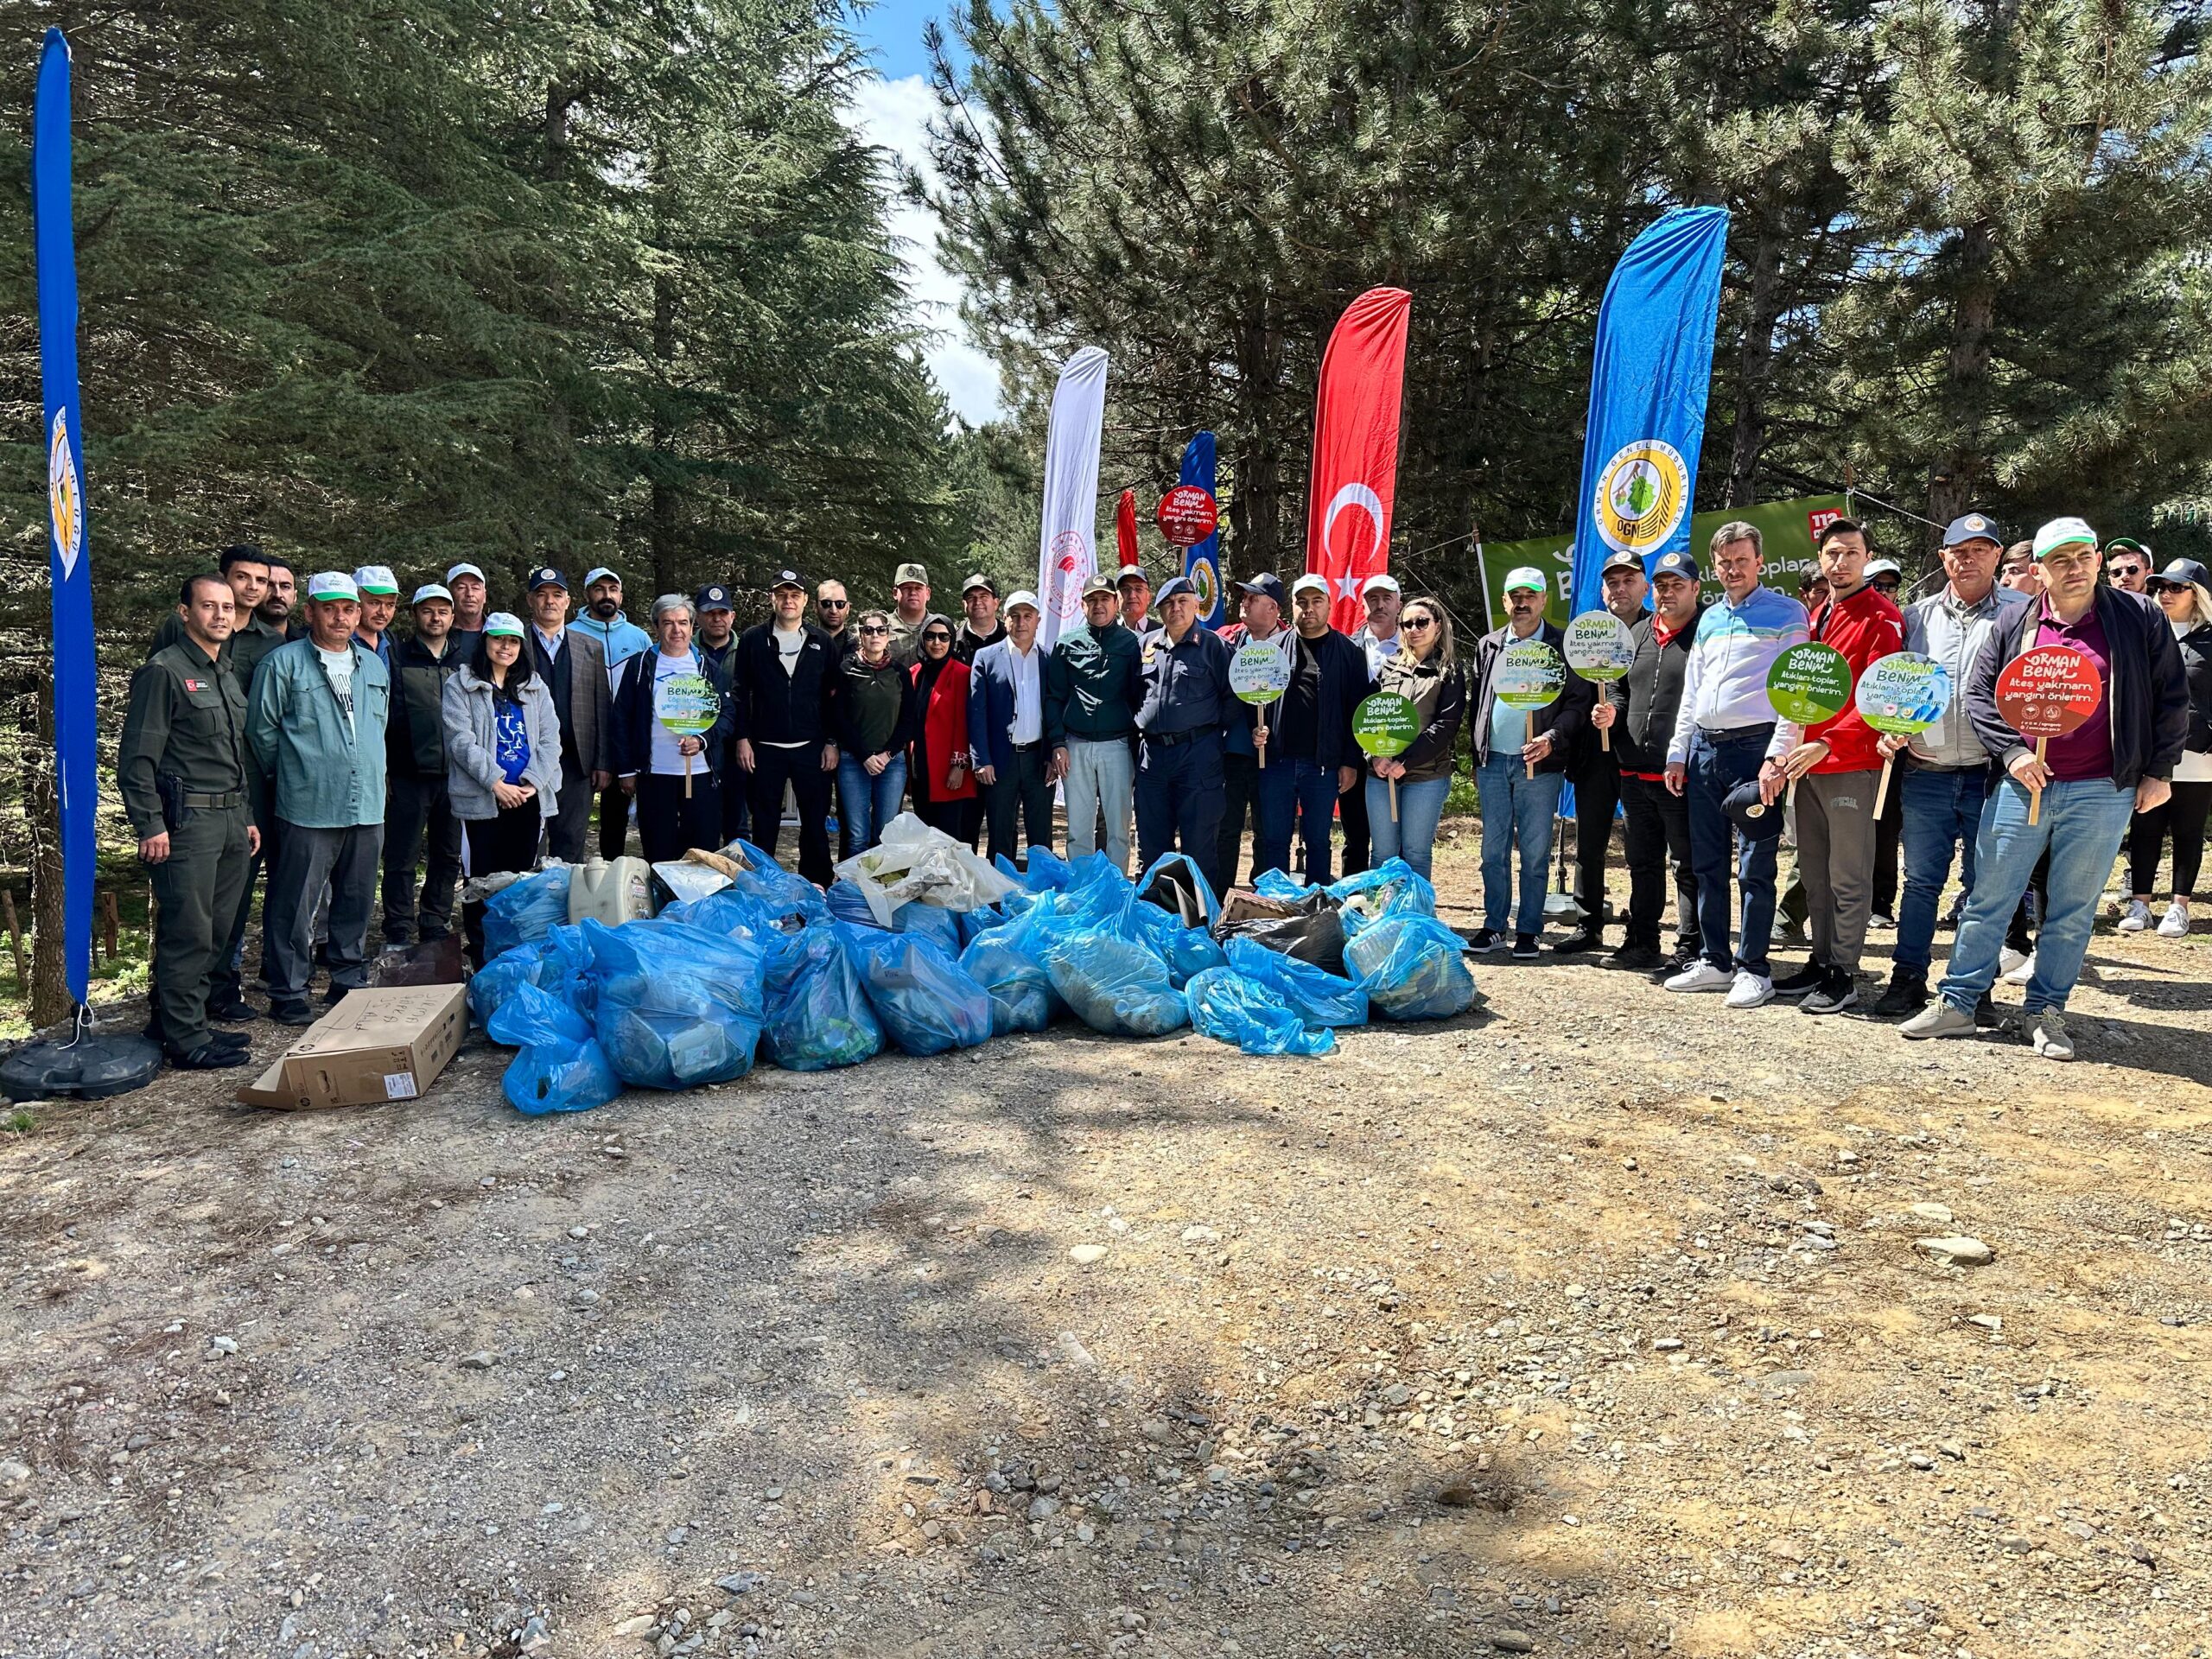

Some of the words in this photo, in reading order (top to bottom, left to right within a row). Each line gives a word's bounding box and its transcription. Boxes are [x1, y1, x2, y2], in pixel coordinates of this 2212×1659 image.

[1597, 476, 1607, 525] ORMAN
[1611, 442, 1650, 466] GENEL
[1174, 490, 1206, 501] ORMAN
[1617, 520, 1640, 539] OGM
[1574, 619, 1616, 629] ORMAN
[1240, 647, 1276, 657] ORMAN
[1507, 648, 1549, 658] ORMAN
[1791, 648, 1836, 664] ORMAN
[2024, 653, 2081, 668] ORMAN
[1880, 658, 1936, 675] ORMAN
[668, 677, 706, 688] ORMAN
[1781, 671, 1810, 681] Atıkları
[1812, 674, 1840, 686] toplar,
[1773, 681, 1805, 692] yangını
[1807, 685, 1843, 696] önlerim.
[1861, 681, 1894, 691] Atıkları
[2009, 677, 2034, 690] Ateş
[2037, 680, 2093, 692] yakmam,
[1866, 693, 1903, 703] yangını
[2005, 691, 2045, 702] yangını
[2047, 693, 2094, 702] önlerim.
[1366, 697, 1402, 708] ORMAN
